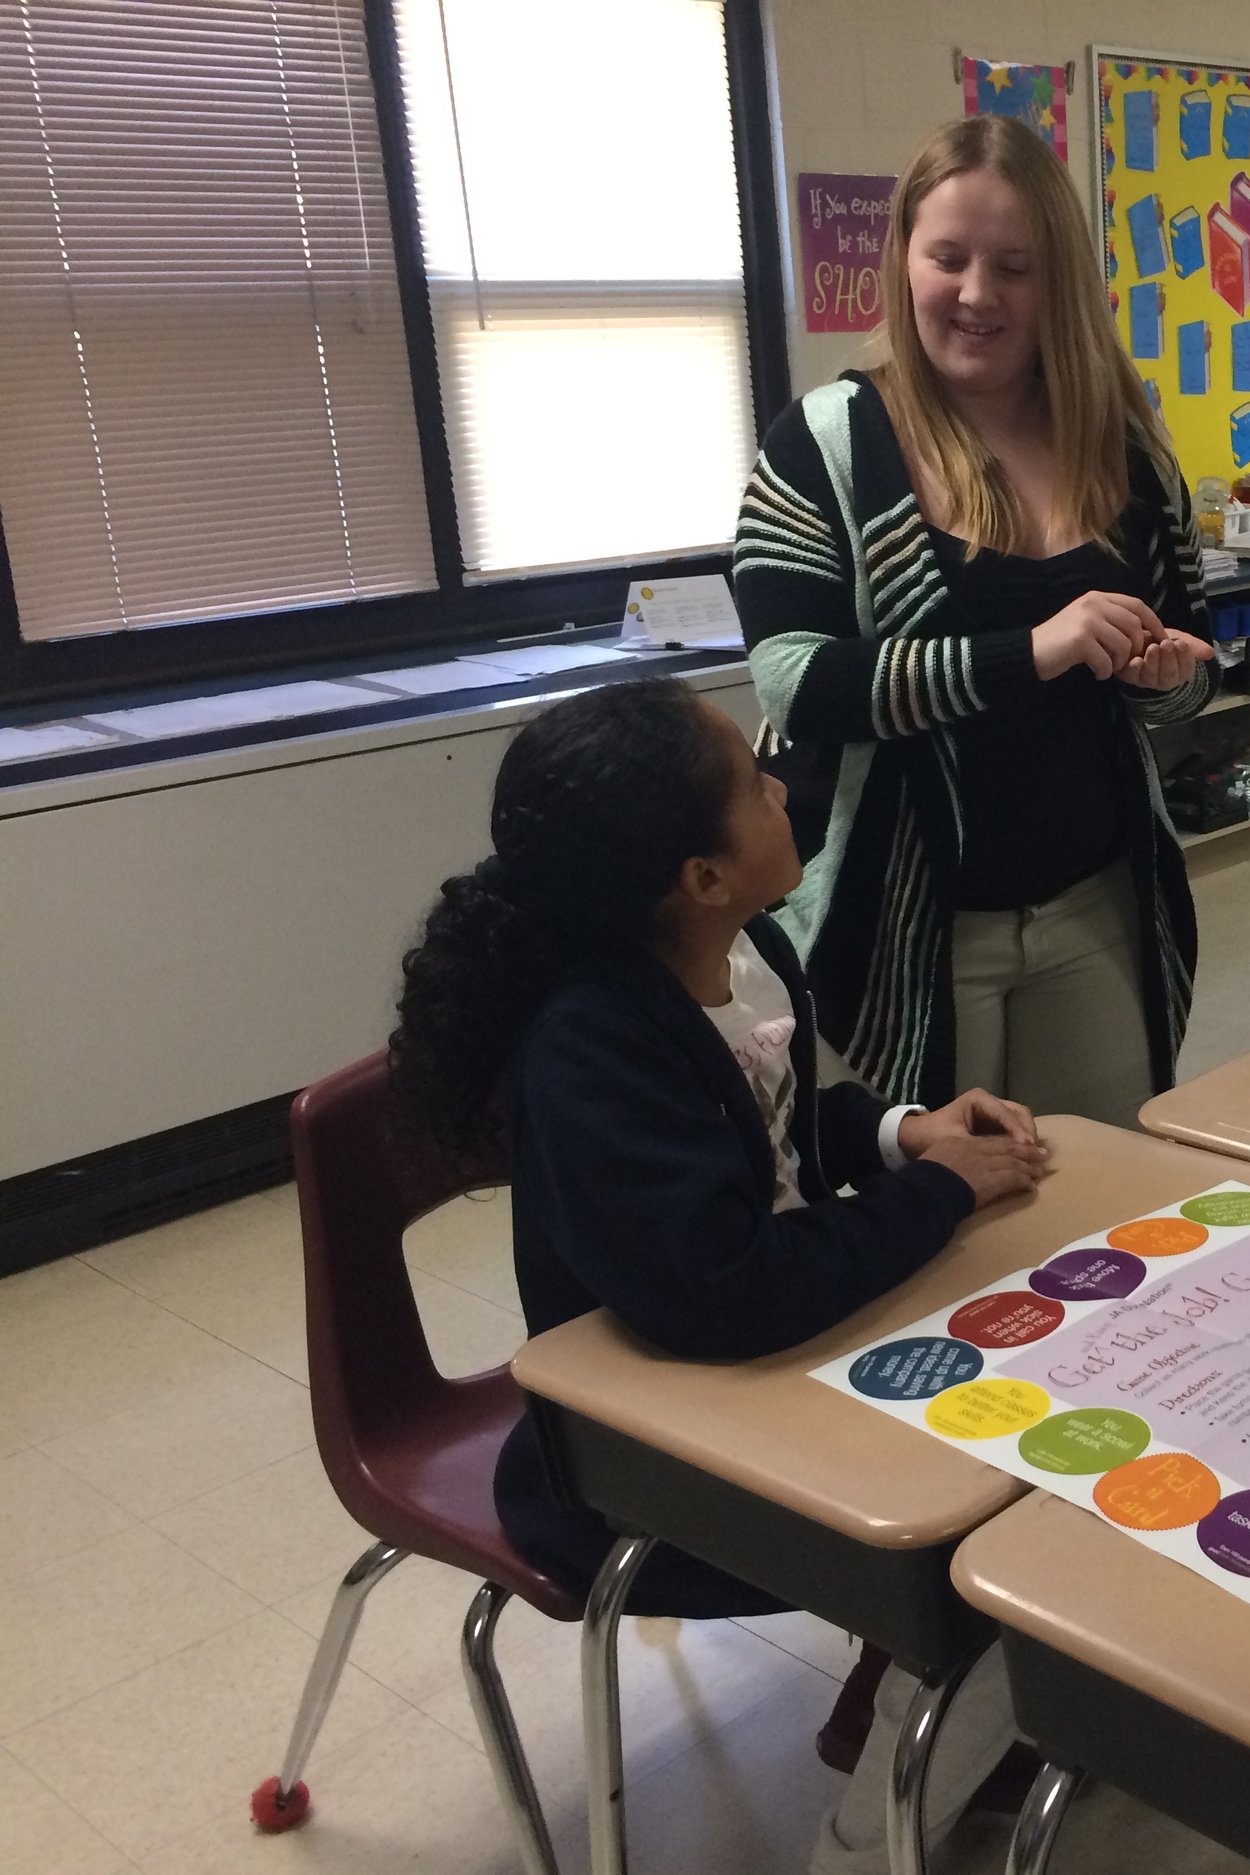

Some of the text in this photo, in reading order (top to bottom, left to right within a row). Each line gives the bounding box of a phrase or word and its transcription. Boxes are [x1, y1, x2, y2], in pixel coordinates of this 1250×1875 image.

[813, 261, 882, 322] SHO
[1091, 1264, 1121, 1282] Move
[1035, 1315, 1056, 1327] You
[1048, 1350, 1115, 1389] Get
[1111, 1324, 1168, 1352] the
[1162, 1286, 1231, 1328] Job!
